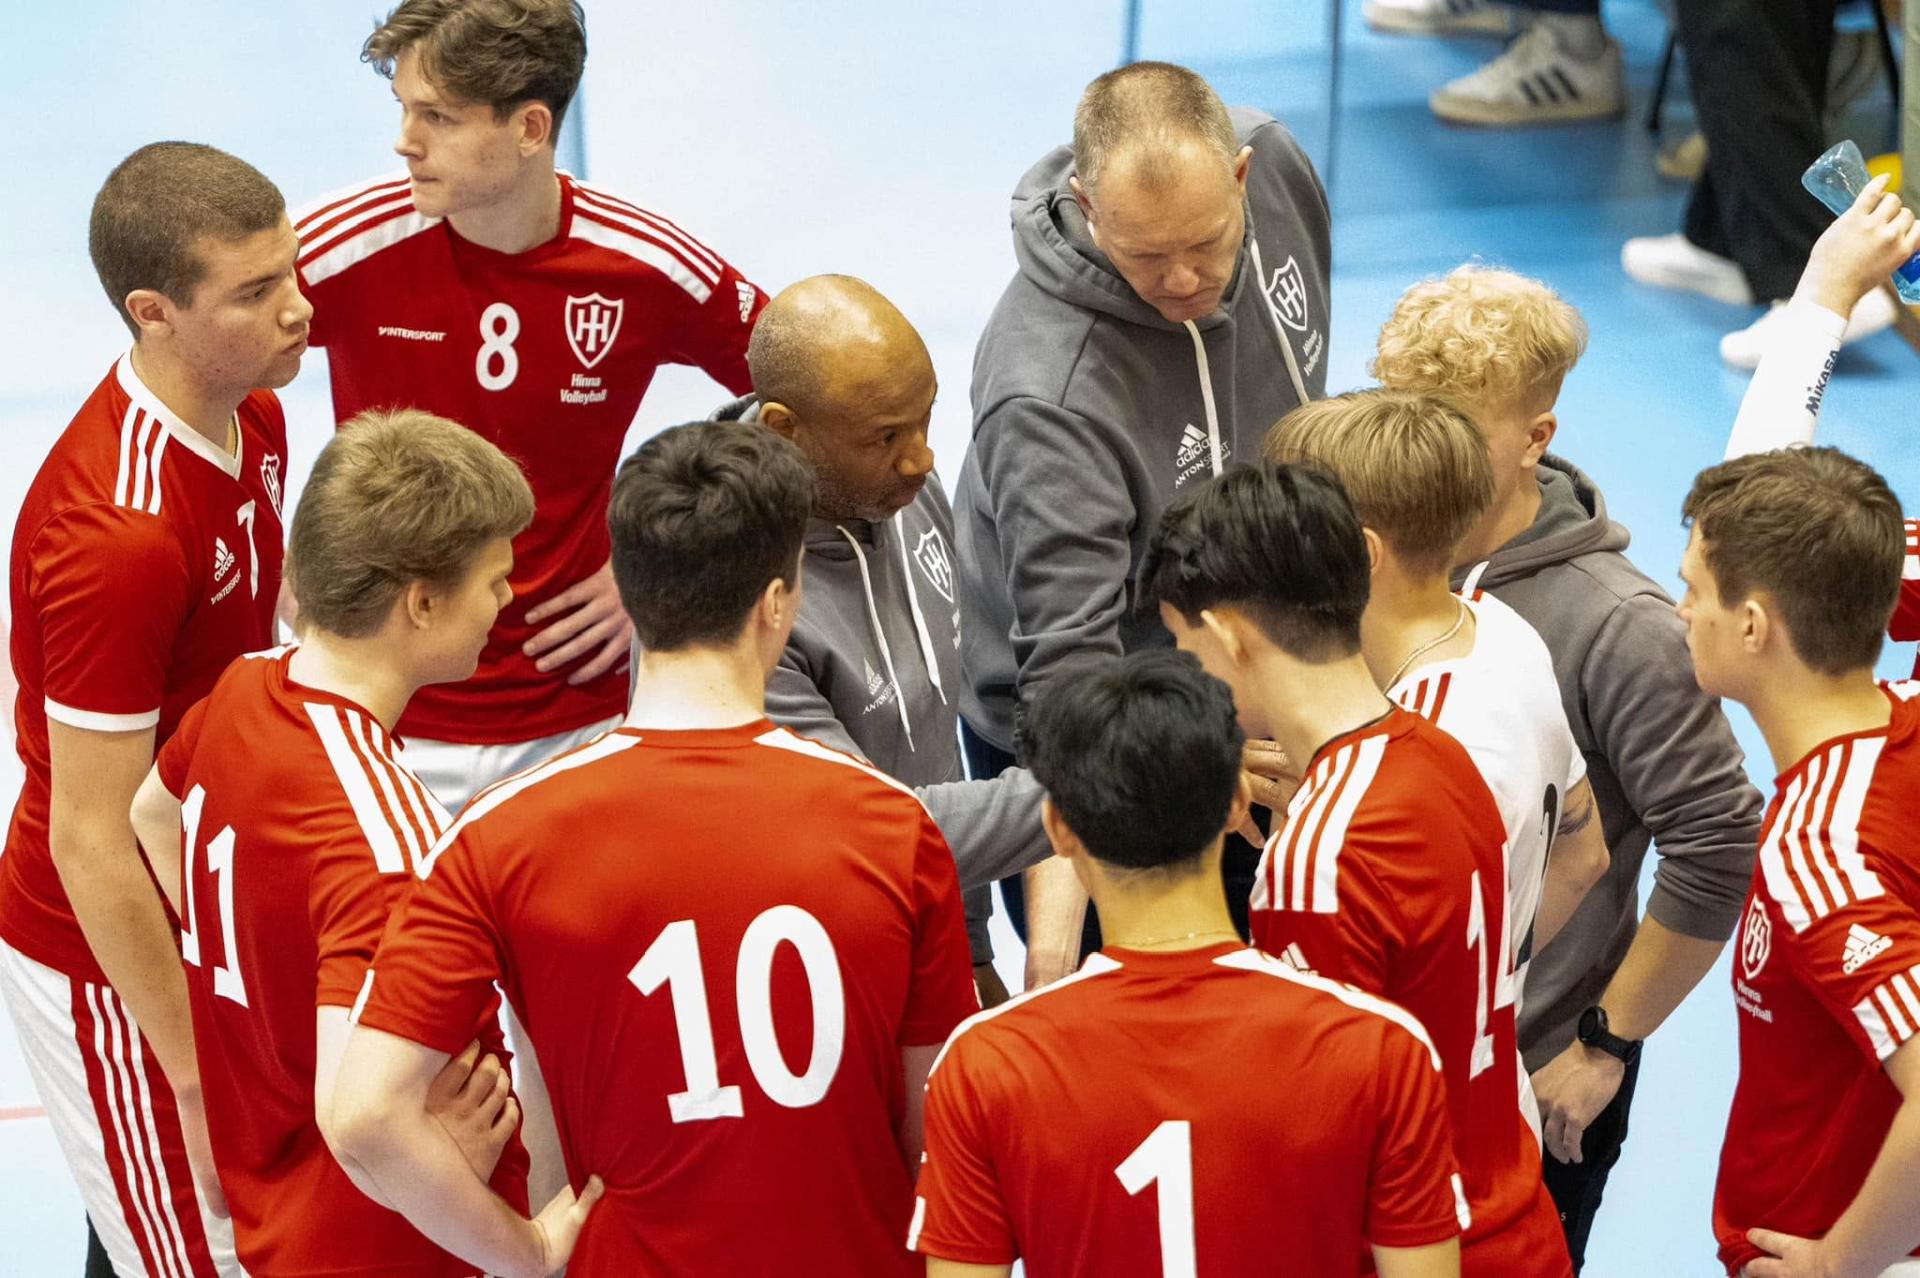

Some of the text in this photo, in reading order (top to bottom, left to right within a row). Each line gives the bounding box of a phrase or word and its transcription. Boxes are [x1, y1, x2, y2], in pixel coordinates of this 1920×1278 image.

[475, 302, 520, 391] 8
[560, 389, 608, 405] Volleyball
[571, 373, 602, 387] Hinna
[1176, 438, 1211, 468] adida
[181, 783, 249, 1009] 11
[1843, 936, 1894, 975] adidas
[627, 904, 846, 1124] 10
[1114, 1120, 1198, 1278] 1
